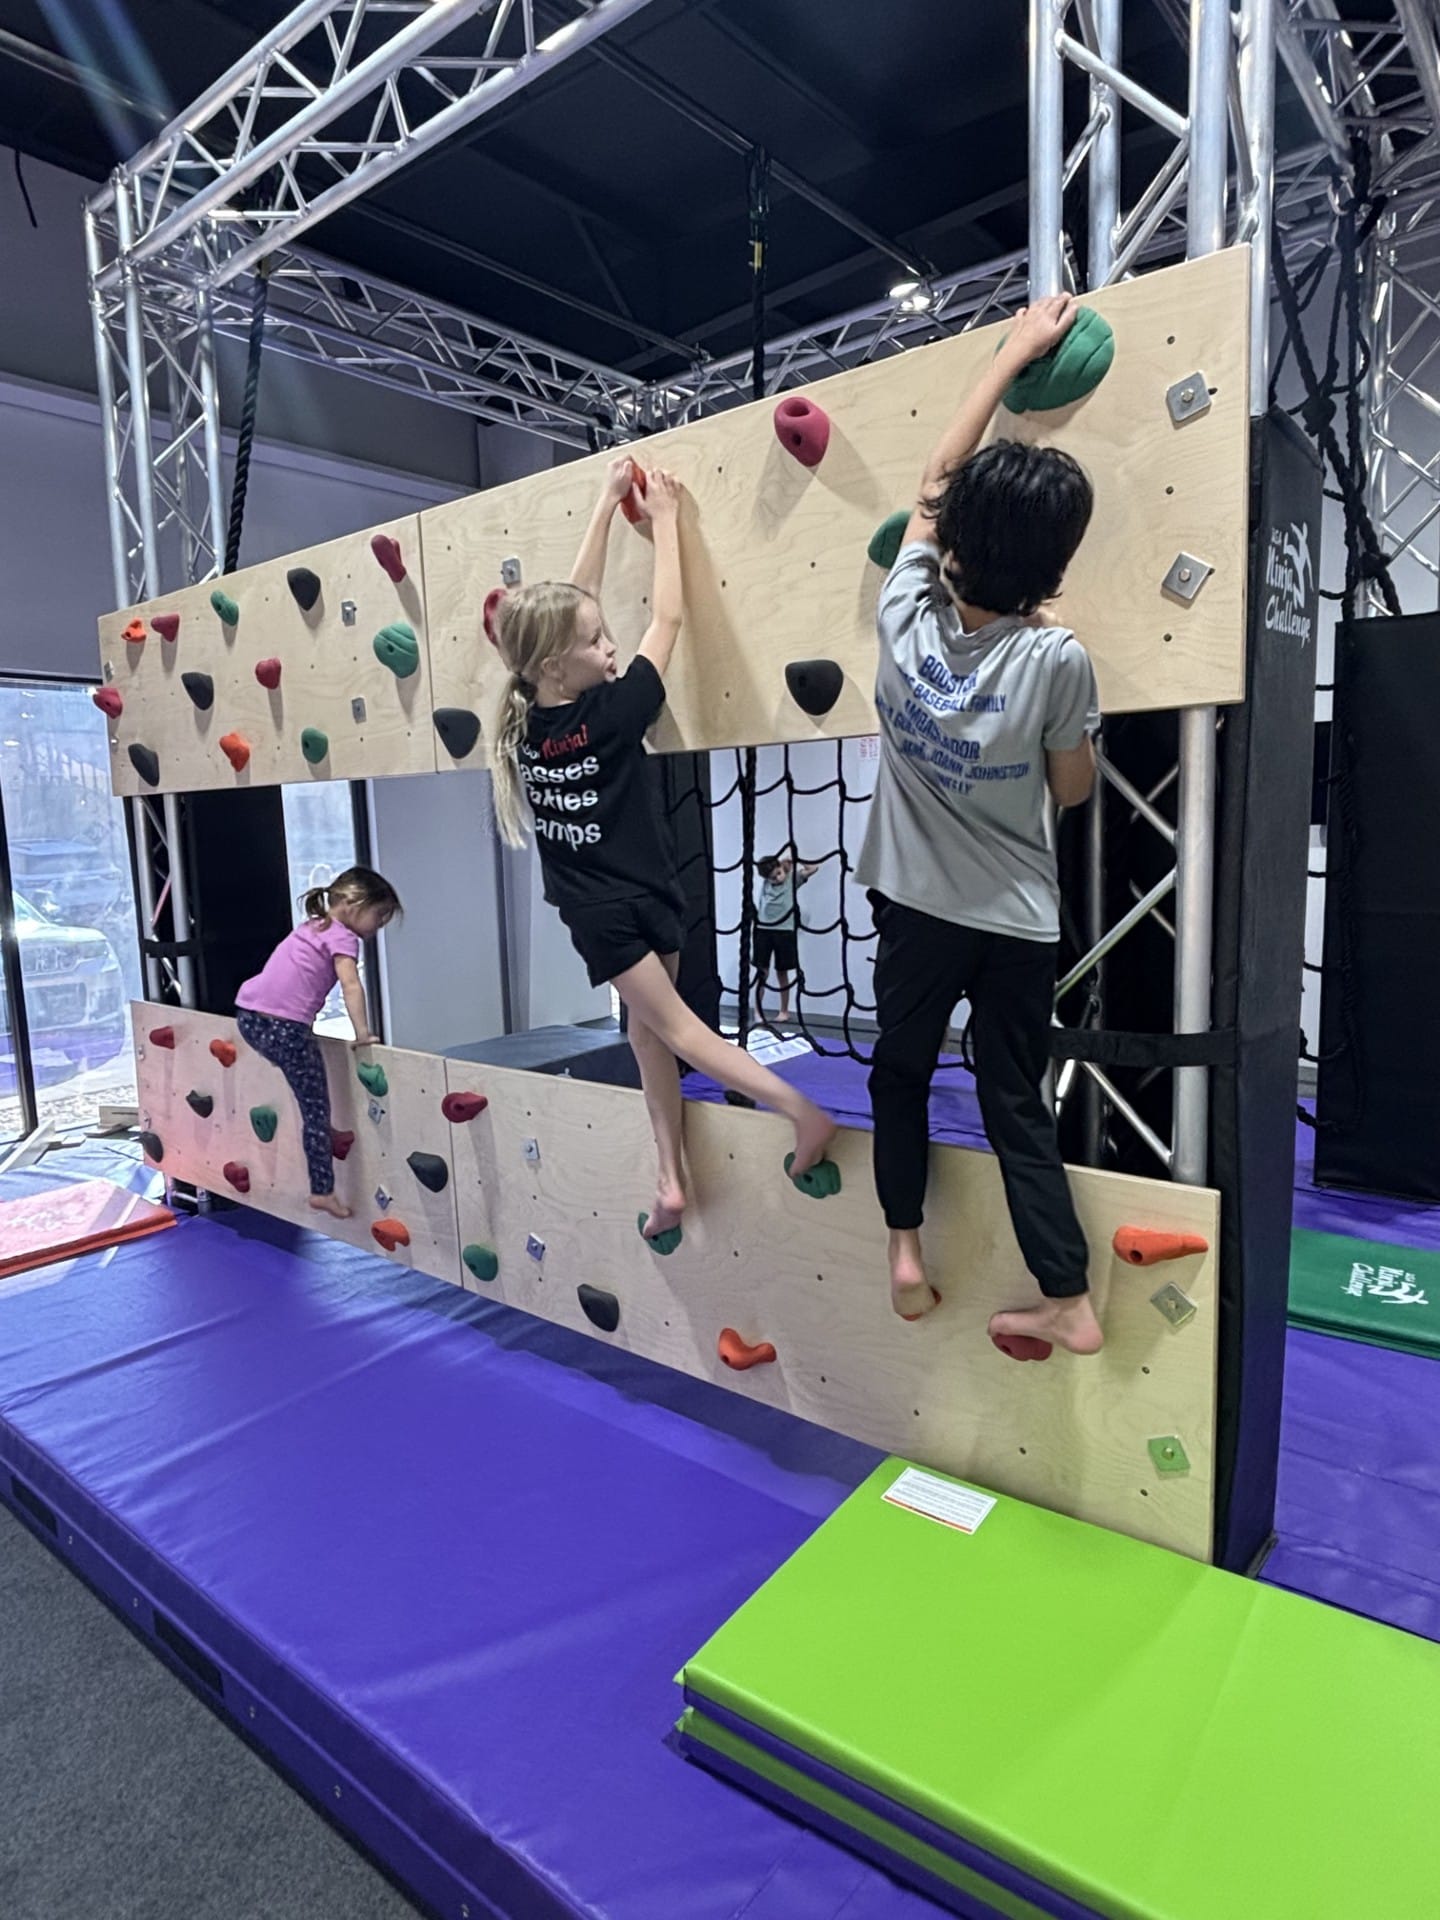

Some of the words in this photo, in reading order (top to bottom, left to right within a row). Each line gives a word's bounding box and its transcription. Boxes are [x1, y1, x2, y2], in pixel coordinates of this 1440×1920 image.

[1266, 544, 1293, 600] Ninja
[1265, 594, 1311, 648] Challenge
[520, 756, 600, 784] asses
[535, 817, 602, 852] amps
